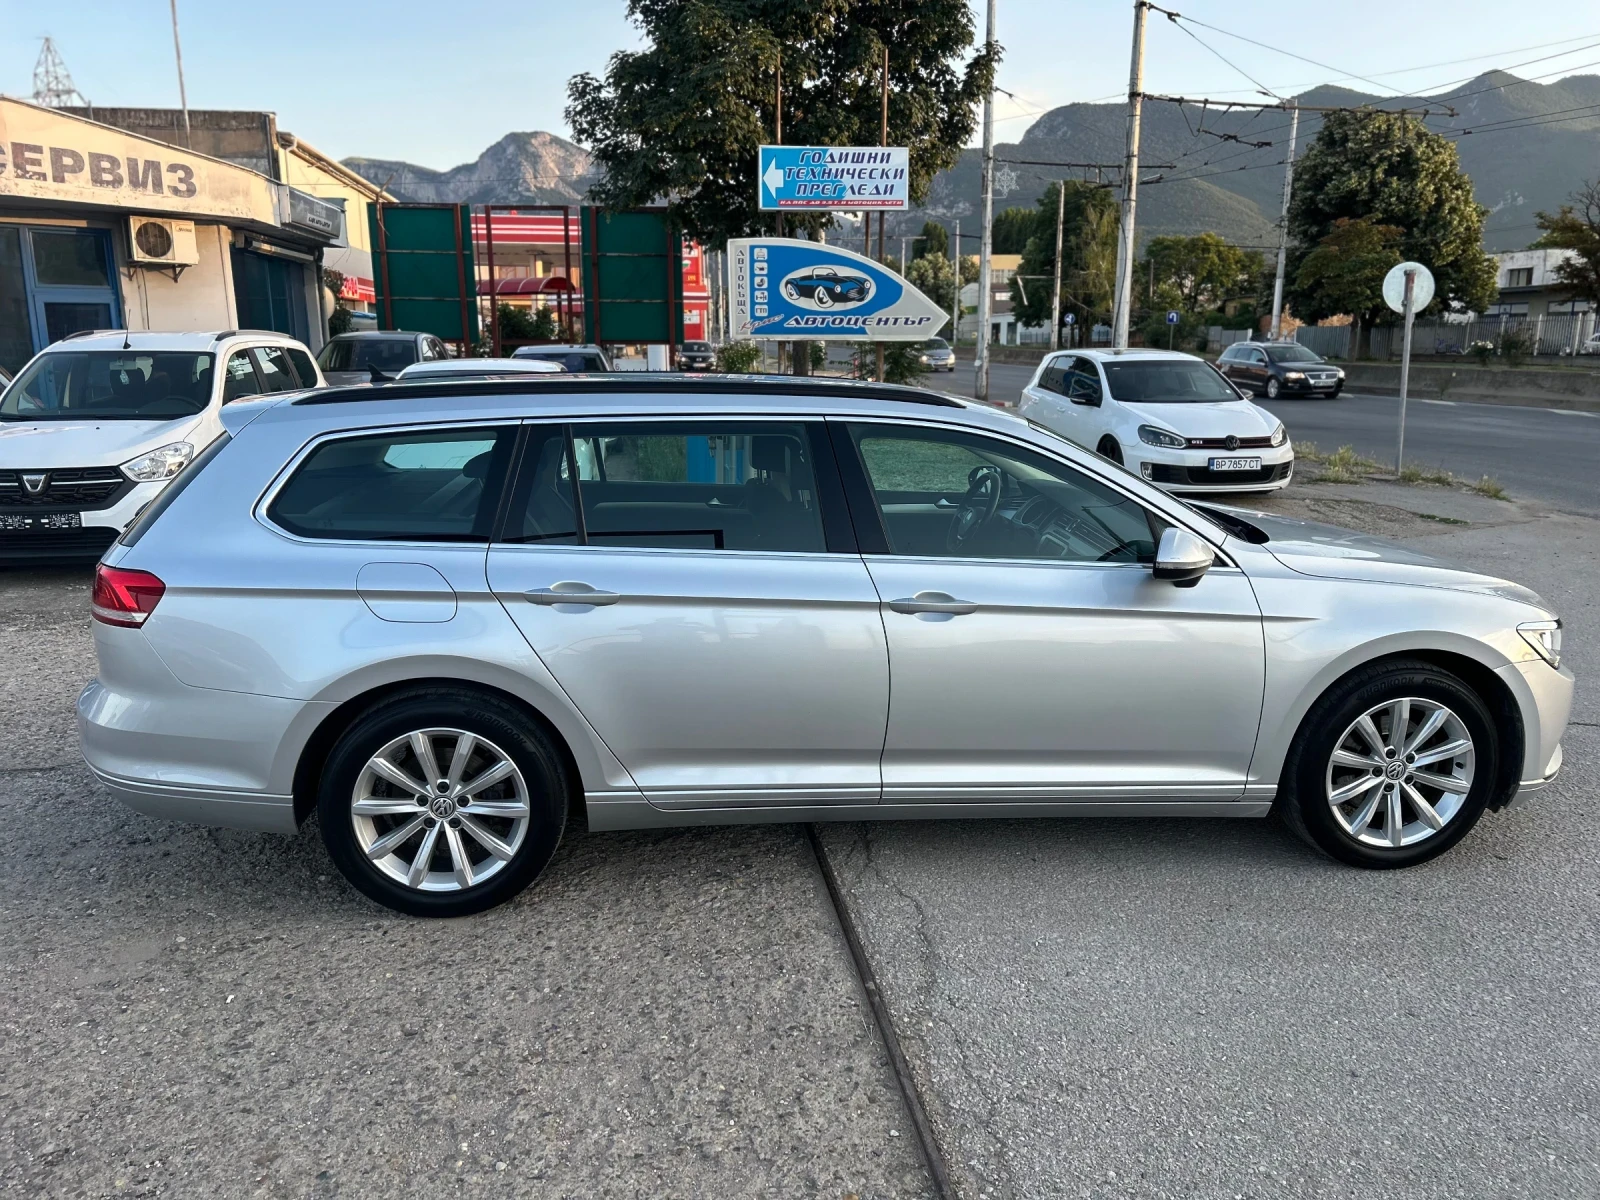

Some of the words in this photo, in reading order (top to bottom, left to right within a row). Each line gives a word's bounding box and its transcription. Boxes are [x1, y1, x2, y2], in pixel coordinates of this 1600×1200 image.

[799, 151, 892, 164] ГОДИШНИ
[0, 142, 197, 198] ЕРВИЗ
[785, 167, 905, 180] ТЕХНИЧЕСКИ
[795, 183, 895, 196] ПРЕГЛЕДИ
[785, 315, 932, 328] АВТОЦЕНТЪР
[1215, 460, 1227, 469] BP
[1228, 460, 1248, 469] 7857
[1249, 460, 1260, 469] CT
